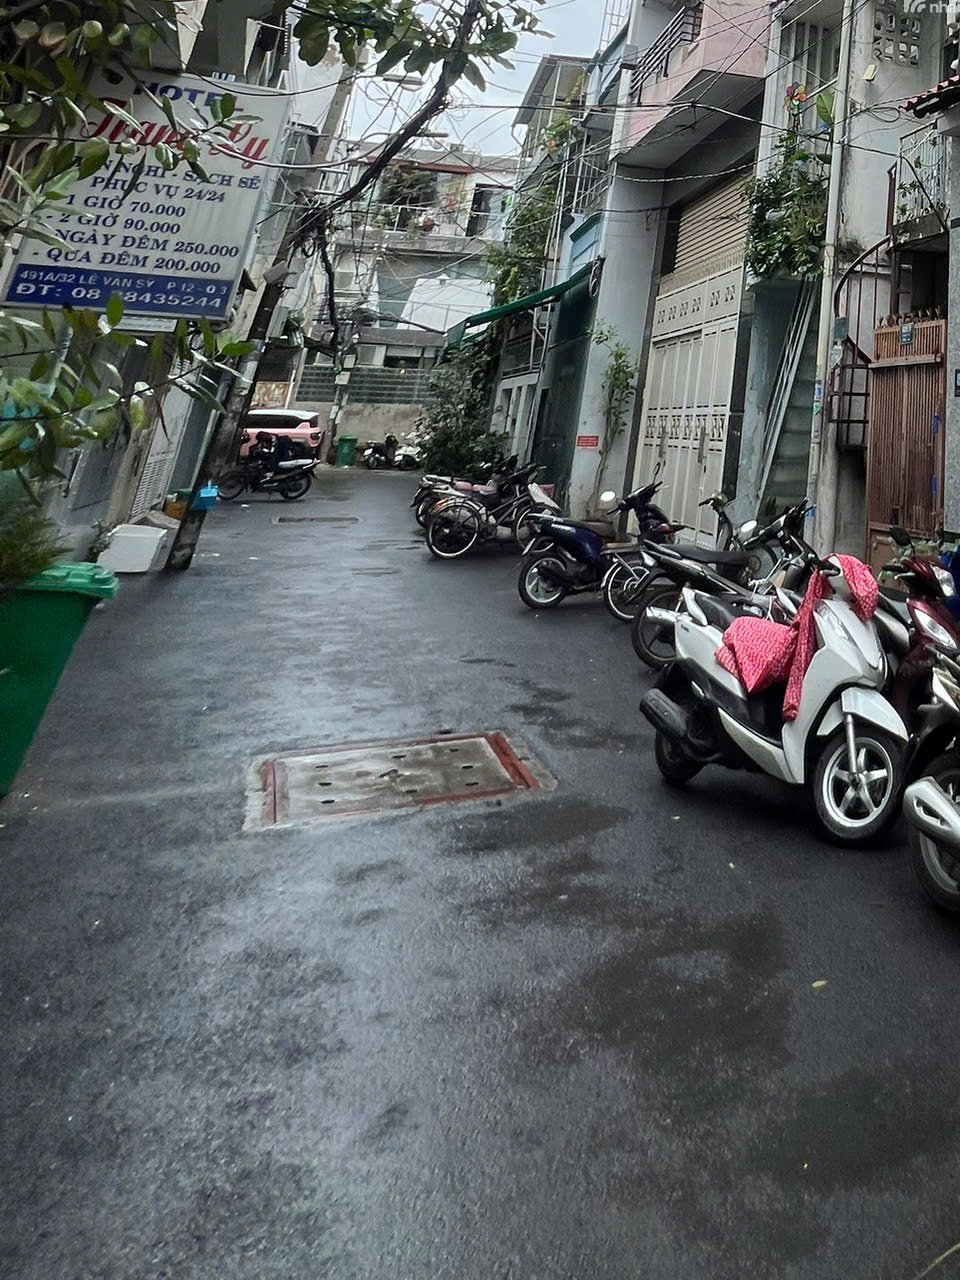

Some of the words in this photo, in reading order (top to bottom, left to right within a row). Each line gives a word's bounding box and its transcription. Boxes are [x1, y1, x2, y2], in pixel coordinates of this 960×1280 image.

[182, 170, 234, 187] SCH
[183, 187, 226, 203] 24/24
[66, 195, 76, 206] 1
[130, 201, 186, 218] 70.000
[59, 213, 71, 223] 2
[123, 217, 181, 234] 90.000
[56, 228, 116, 246] NGÀY
[120, 234, 169, 251] ĐÊM
[173, 240, 239, 258] 250.000
[98, 250, 149, 268] ĐÊM
[153, 257, 221, 274] 200.000
[20, 270, 76, 284] 491A/32
[71, 287, 101, 300] 08
[112, 290, 222, 309] 8435244
